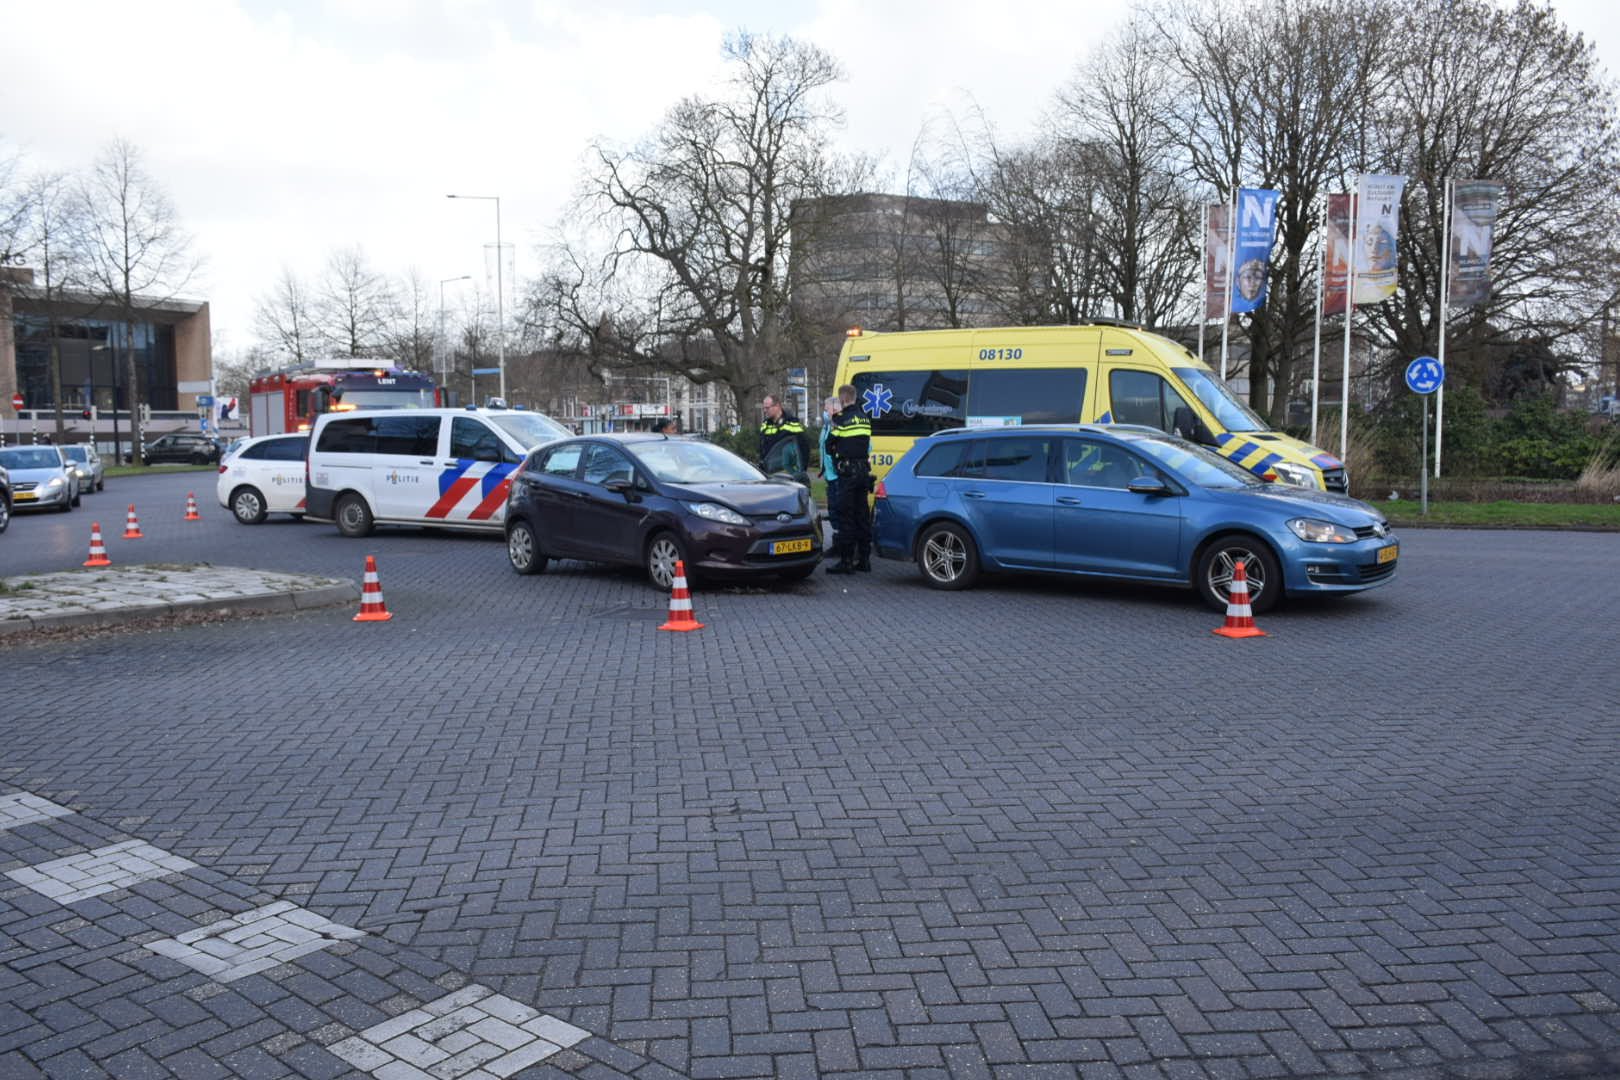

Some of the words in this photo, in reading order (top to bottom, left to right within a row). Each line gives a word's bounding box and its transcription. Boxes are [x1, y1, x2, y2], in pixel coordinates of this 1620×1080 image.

[1242, 195, 1273, 228] N
[1381, 203, 1393, 215] N
[979, 348, 1022, 360] 08130
[271, 474, 303, 485] POLITIE
[386, 471, 419, 484] POLITIE
